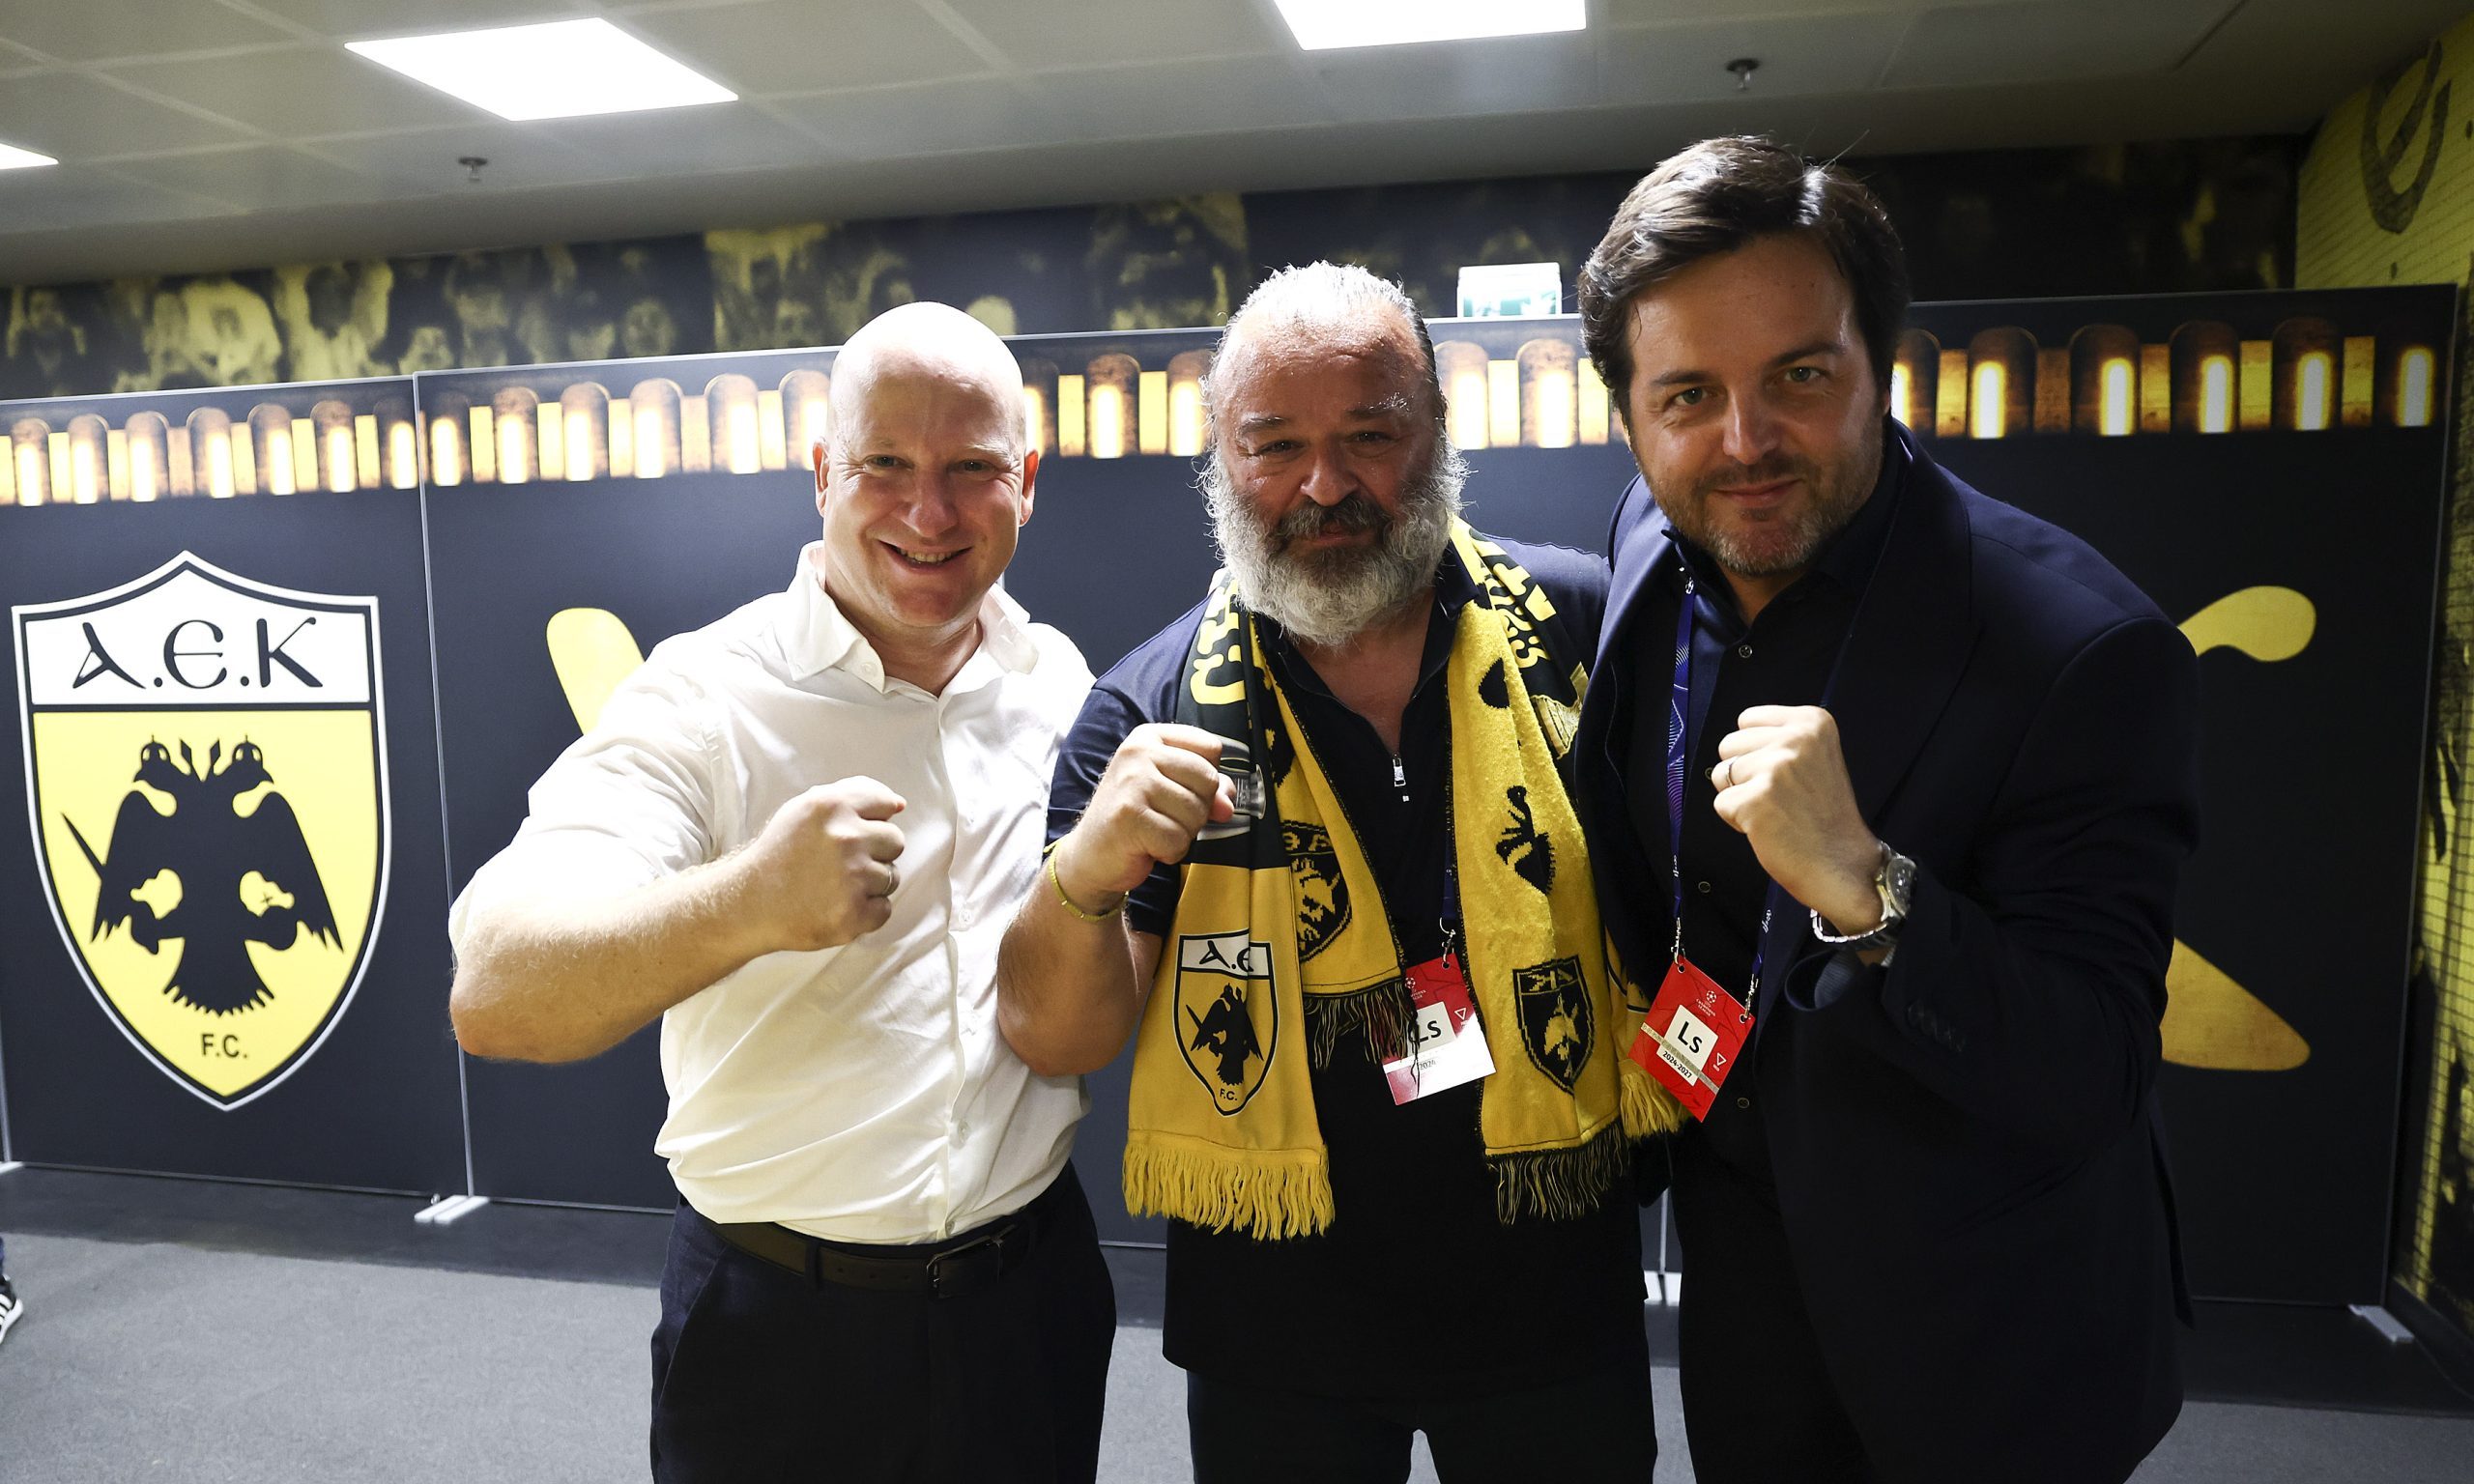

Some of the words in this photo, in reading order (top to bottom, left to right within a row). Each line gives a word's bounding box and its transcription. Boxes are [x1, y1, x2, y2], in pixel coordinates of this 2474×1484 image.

[201, 1034, 249, 1059] F.C.
[1662, 1051, 1692, 1078] 2024-2027
[1220, 1088, 1238, 1101] F.C.
